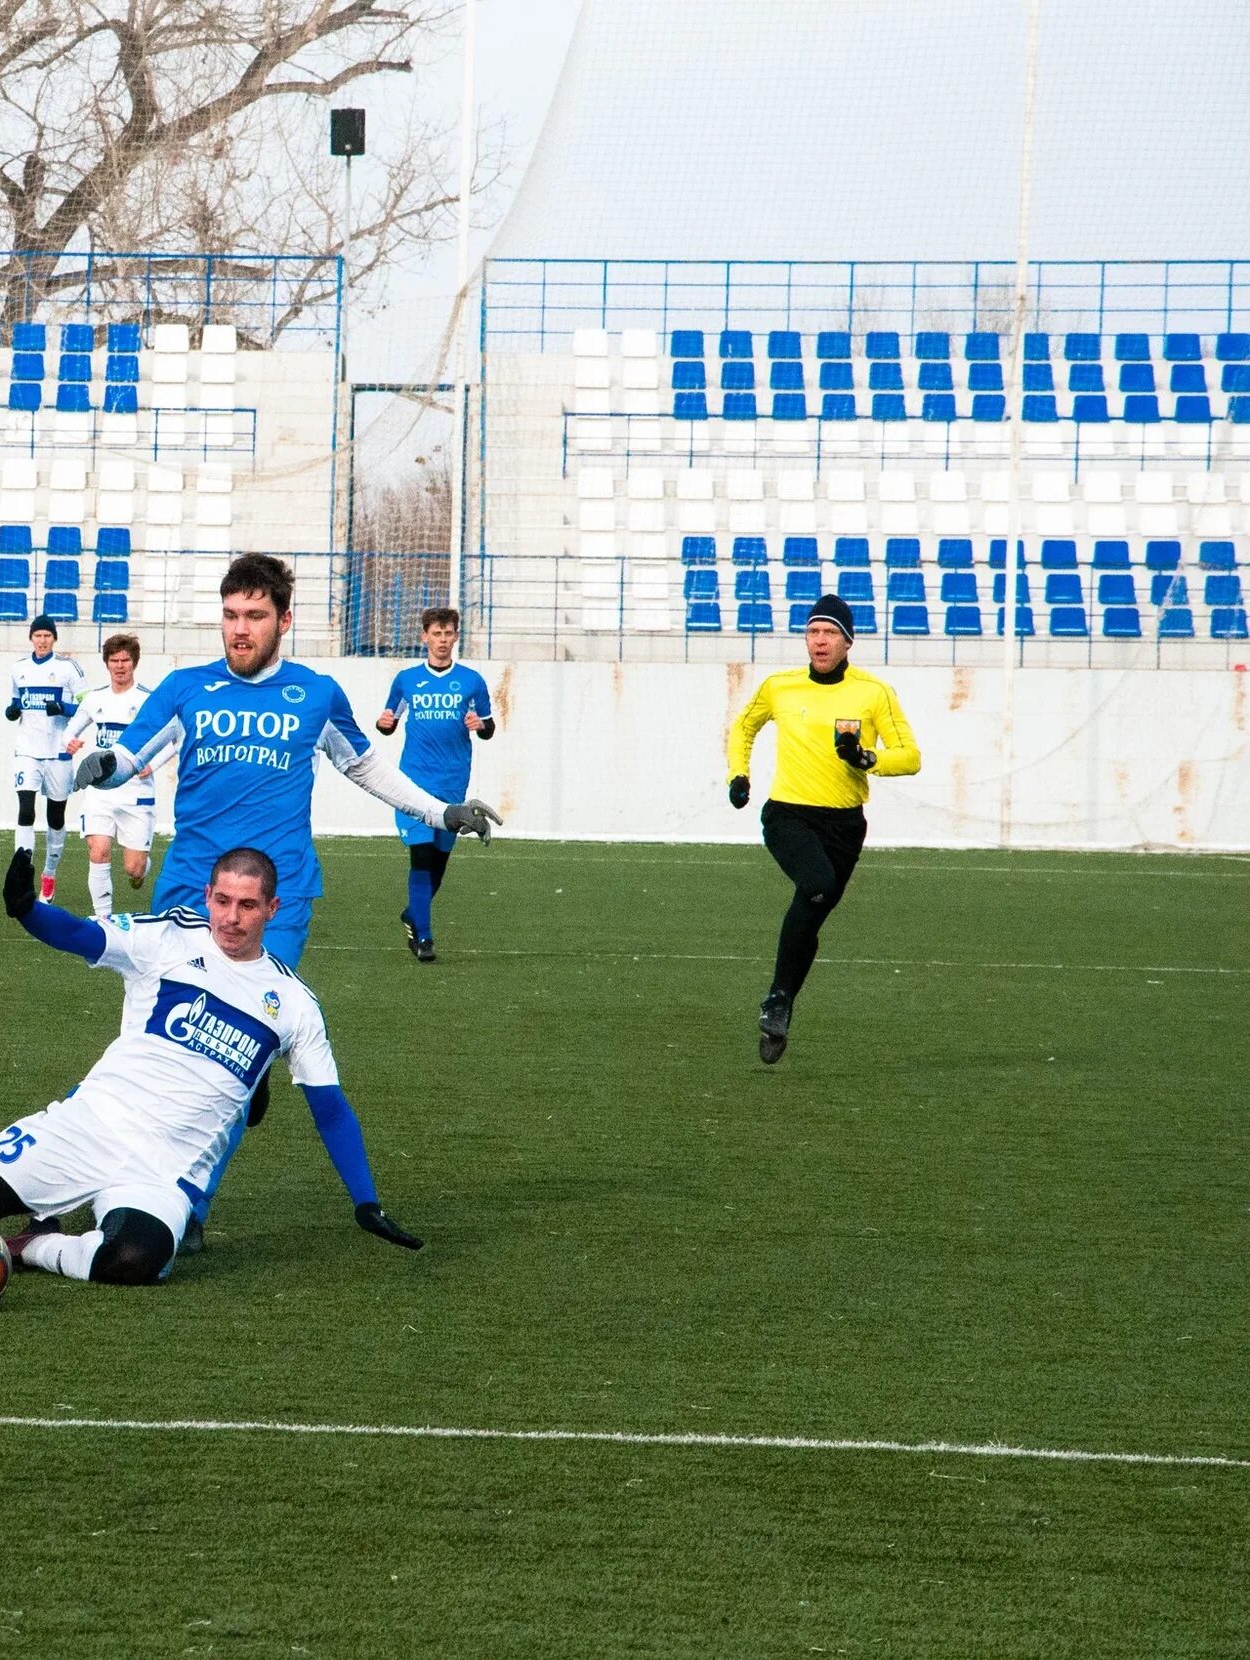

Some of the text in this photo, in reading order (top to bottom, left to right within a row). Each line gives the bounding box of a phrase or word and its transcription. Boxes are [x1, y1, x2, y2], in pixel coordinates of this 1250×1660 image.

[412, 693, 463, 709] РОТОР
[195, 709, 300, 741] РОТОР
[196, 744, 292, 771] ВОЛГОГРАД
[193, 1030, 250, 1069] ДОБЫЧА
[198, 1011, 261, 1061] ГАЗПРОМ
[187, 1039, 245, 1078] АСТРАХАНЬ
